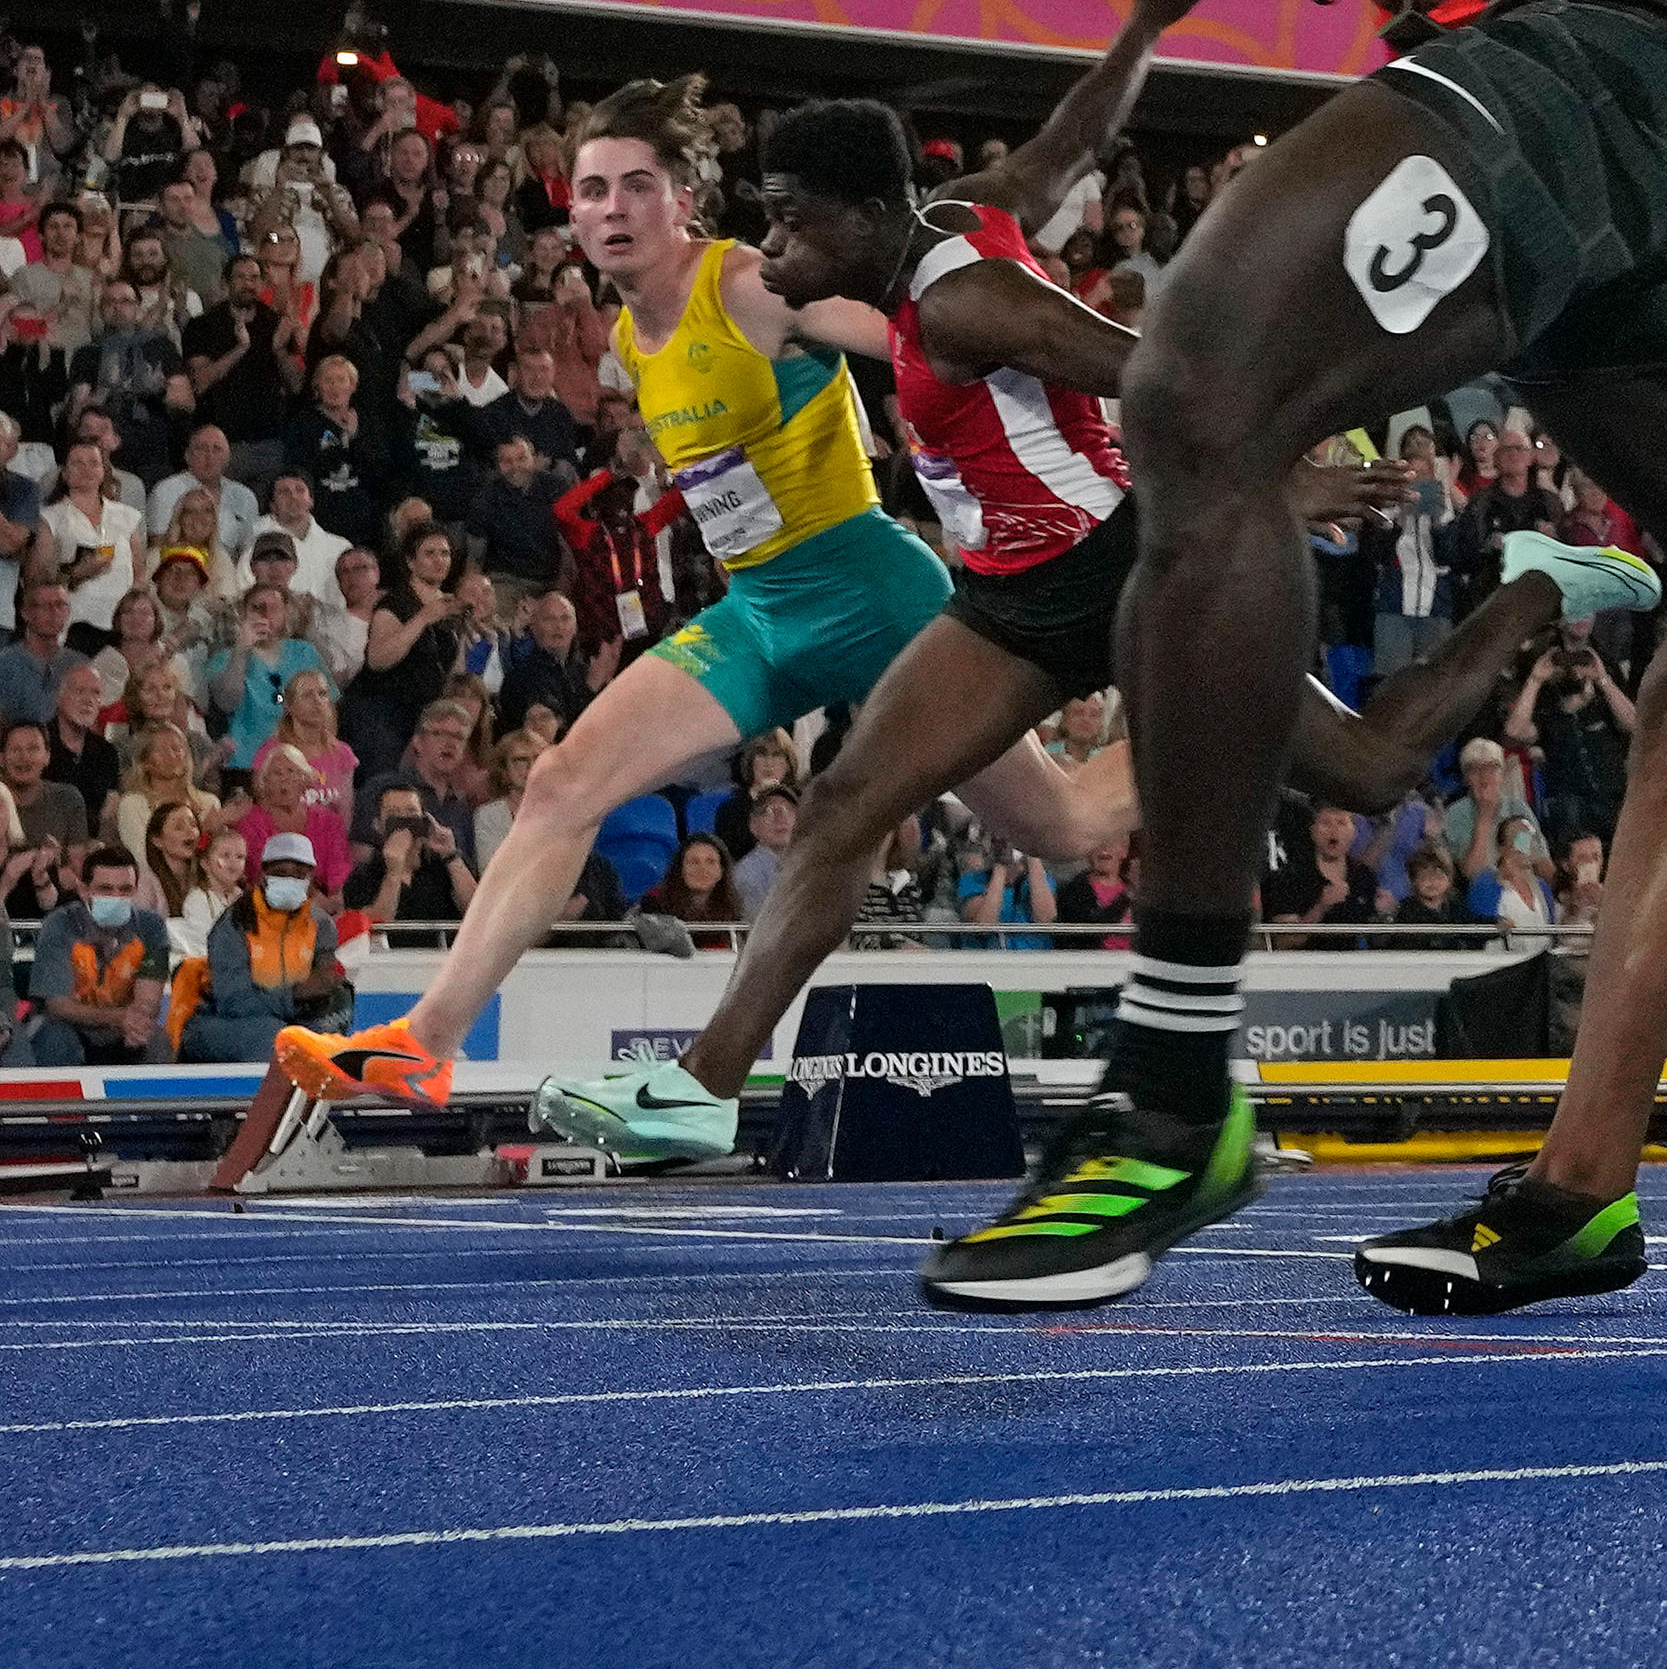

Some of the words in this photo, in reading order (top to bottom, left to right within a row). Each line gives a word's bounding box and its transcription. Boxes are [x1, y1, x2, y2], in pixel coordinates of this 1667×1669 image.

[1369, 193, 1458, 293] 3
[1246, 1019, 1333, 1060] sport
[1344, 1019, 1370, 1054] is
[1375, 1018, 1436, 1061] just
[844, 1051, 1005, 1079] LONGINES
